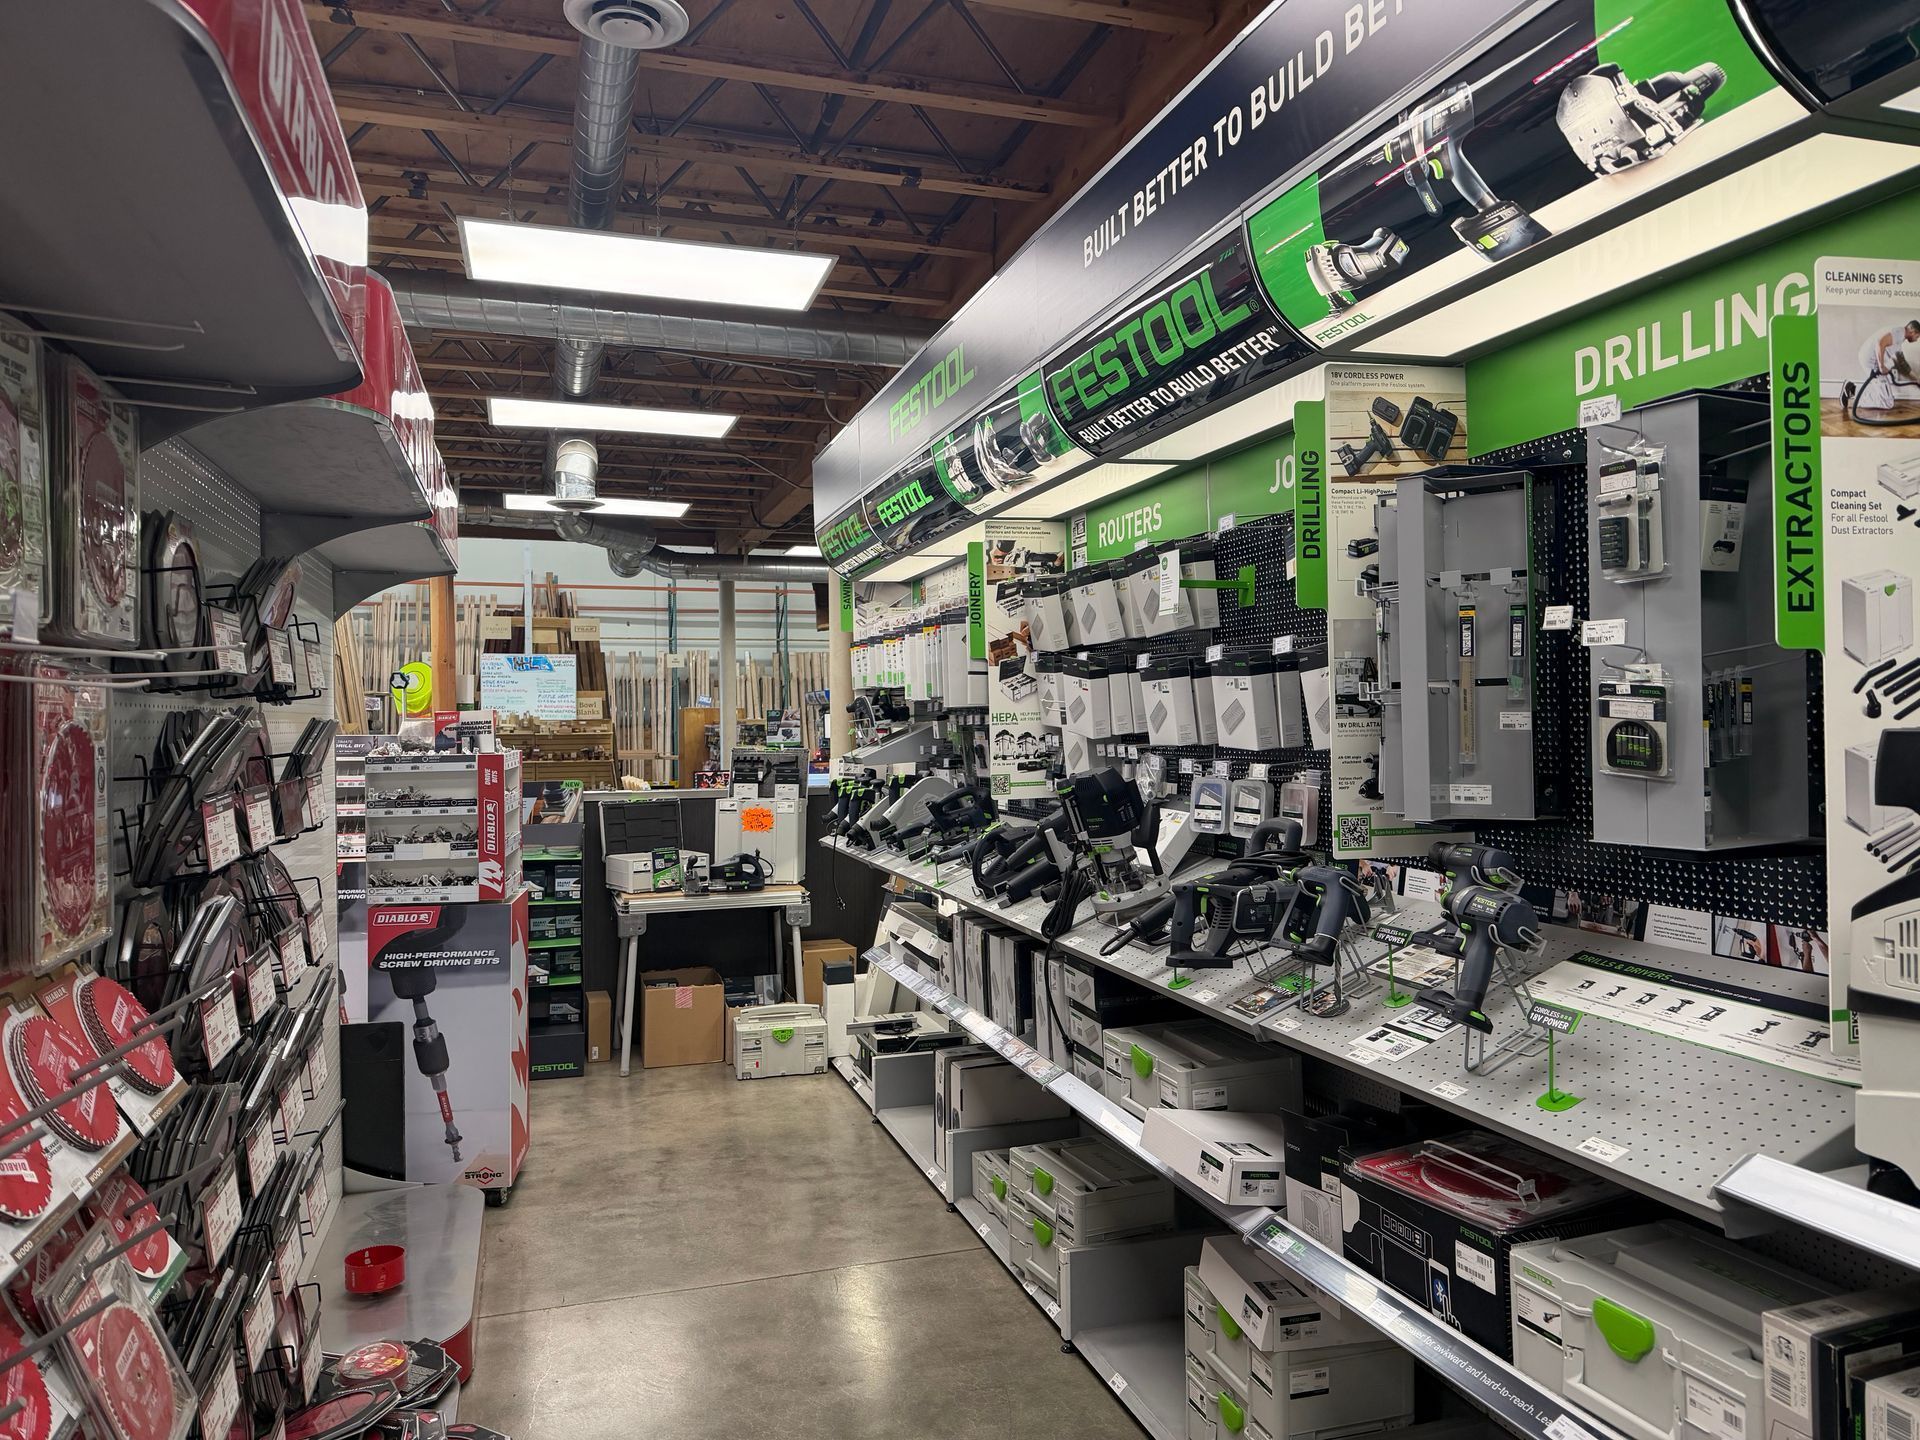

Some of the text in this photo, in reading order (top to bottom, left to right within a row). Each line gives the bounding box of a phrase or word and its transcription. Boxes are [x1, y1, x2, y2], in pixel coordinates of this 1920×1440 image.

[1083, 0, 1403, 269] BUILT BETTER TO BUILD BE
[1825, 271, 1903, 285] CLEANING SETS
[1825, 286, 1843, 295] Keep
[1845, 287, 1861, 295] your
[1863, 288, 1892, 298] cleaning
[1315, 312, 1375, 343] FESTOOL
[1575, 272, 1810, 396] DRILLING
[1344, 372, 1378, 380] CORDLESS
[889, 342, 975, 444] FESTOOL
[1077, 414, 1111, 444] BUILT
[1111, 391, 1152, 430] BETTER
[1151, 383, 1174, 409] TO
[1174, 363, 1217, 397] BUILD
[1783, 361, 1815, 612] EXTRACTORS
[1830, 489, 1866, 498] Compact
[876, 480, 934, 527] FESTOOL
[1301, 450, 1321, 558] DRILLING
[1830, 502, 1882, 511] Cleaning Set
[1099, 502, 1162, 549] ROUTERS
[1832, 514, 1888, 522] For all Festool
[819, 513, 872, 559] FESTOOL
[1832, 526, 1894, 535] Dust Extractors
[970, 572, 981, 628] JOINERY
[992, 712, 1018, 722] HEPA
[1617, 758, 1646, 767] FESTOOL
[486, 813, 496, 852] DIABLO
[1474, 896, 1498, 908] FESTOOL
[377, 914, 418, 924] DIABLO
[1376, 932, 1405, 945] 18V POWER
[1378, 926, 1398, 936] CORDLESS
[379, 957, 500, 968] SCREW DRIVING BITS
[384, 950, 496, 960] HIGH-PERFORMANCE
[1578, 954, 1673, 982] DRILLS & DRIVERS
[46, 987, 65, 1003] DIABLO
[1534, 1006, 1560, 1019] CORDLESS
[1530, 1012, 1570, 1030] 18V POWER
[532, 1062, 578, 1072] FESTOOL
[152, 1107, 164, 1121] WOOD
[89, 1167, 104, 1182] WOOD
[1460, 1226, 1494, 1250] FESTOOL
[14, 1240, 34, 1261] WOOD
[1523, 1266, 1556, 1288] FESTOOL
[1423, 1334, 1434, 1347] for
[1434, 1344, 1467, 1368] awkward
[1466, 1364, 1481, 1378] and
[1480, 1372, 1534, 1416] hard-to-reach.
[1536, 1411, 1552, 1428] Lea
